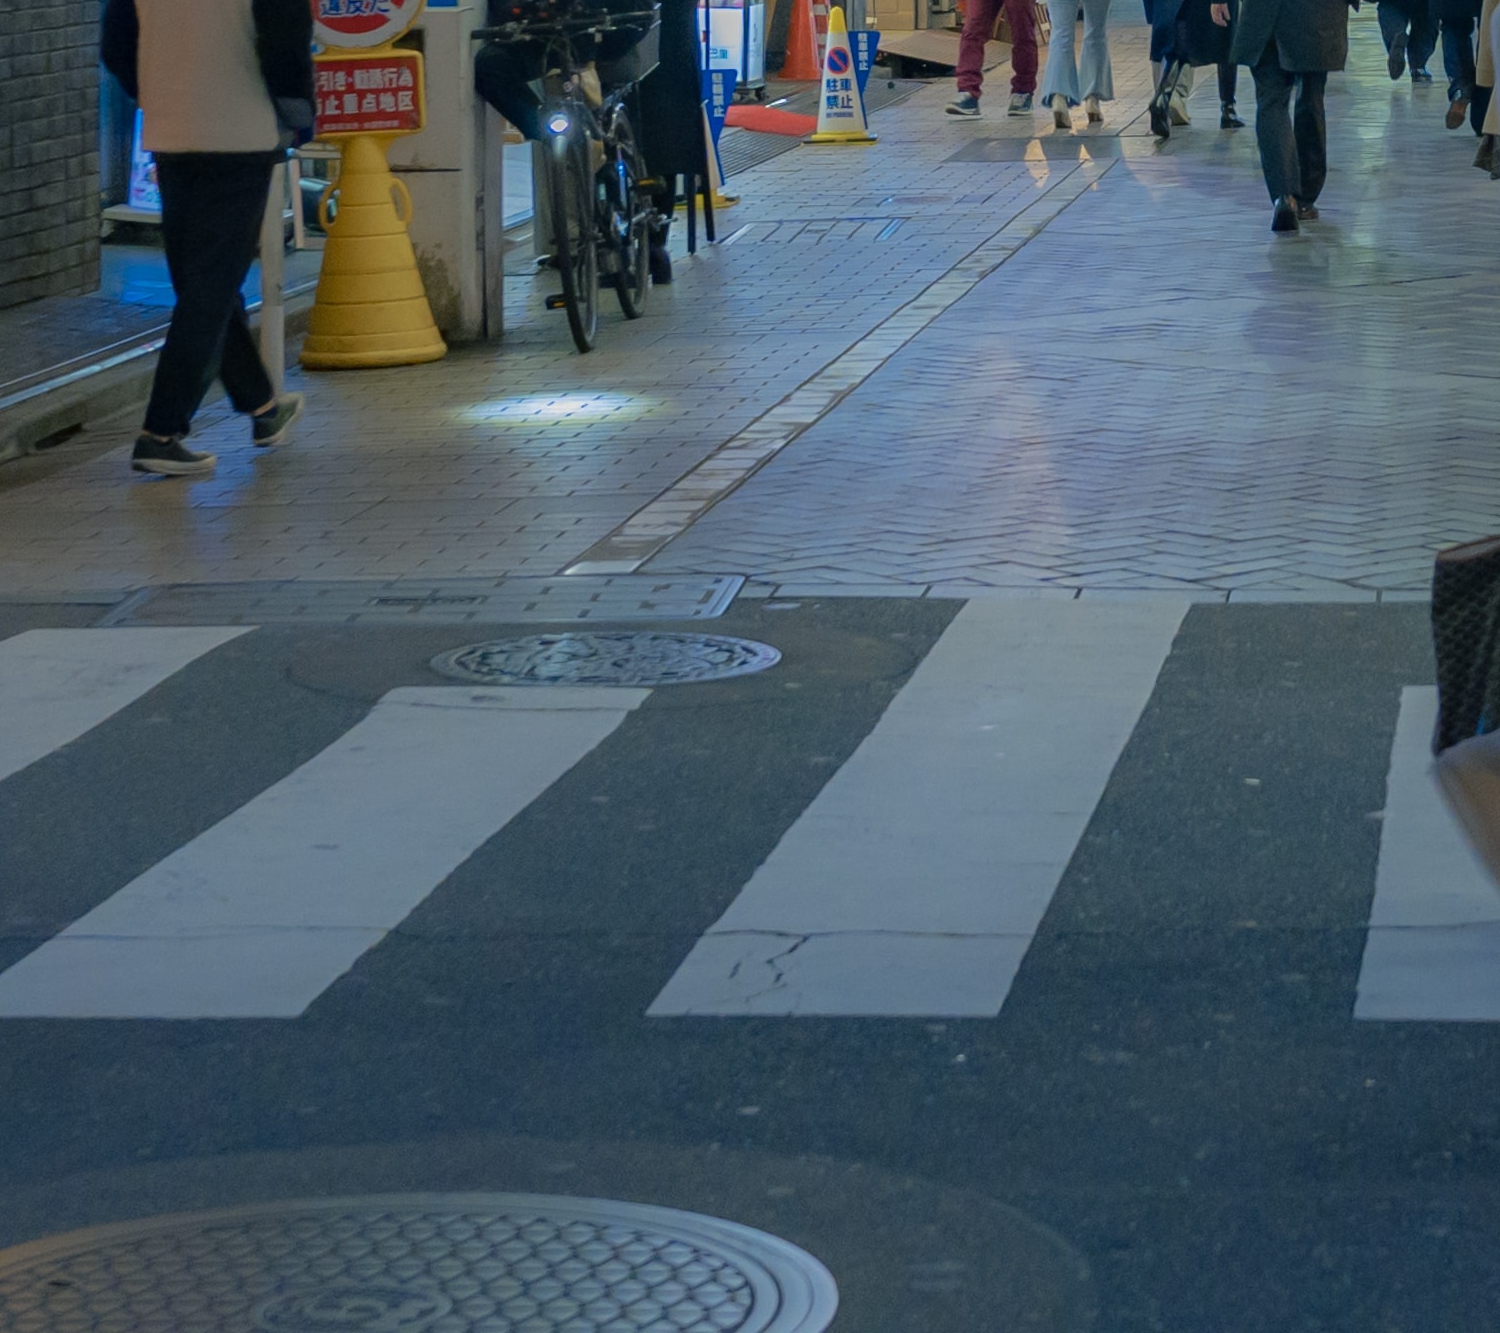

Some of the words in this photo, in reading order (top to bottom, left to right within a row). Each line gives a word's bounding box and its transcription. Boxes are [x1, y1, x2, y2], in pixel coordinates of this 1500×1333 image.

[316, 67, 414, 91] 引き・勧誘行為
